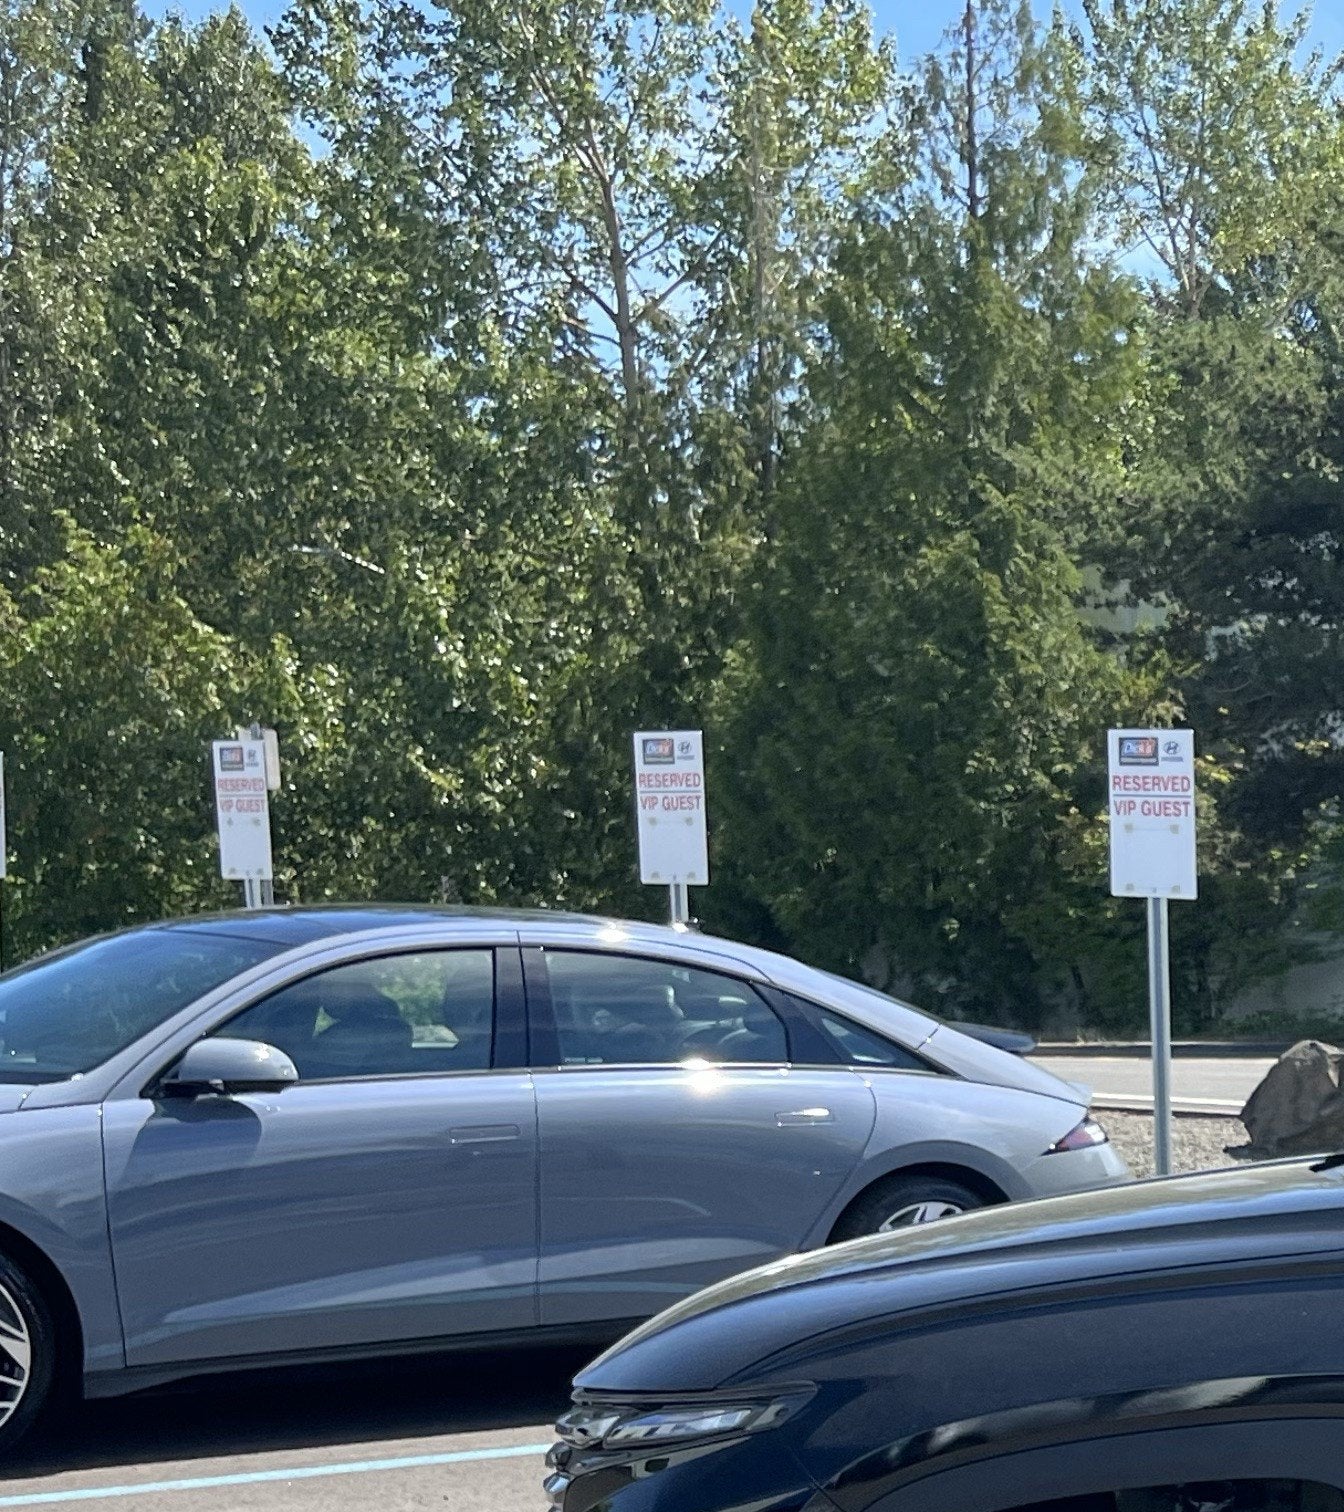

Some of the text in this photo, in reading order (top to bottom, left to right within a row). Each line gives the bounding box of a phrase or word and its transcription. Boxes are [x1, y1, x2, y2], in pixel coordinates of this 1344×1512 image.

[638, 773, 701, 788] RESERVED
[1112, 775, 1191, 792] RESERVED
[640, 795, 701, 810] VIP GUEST
[1113, 800, 1190, 817] VIP GUEST
